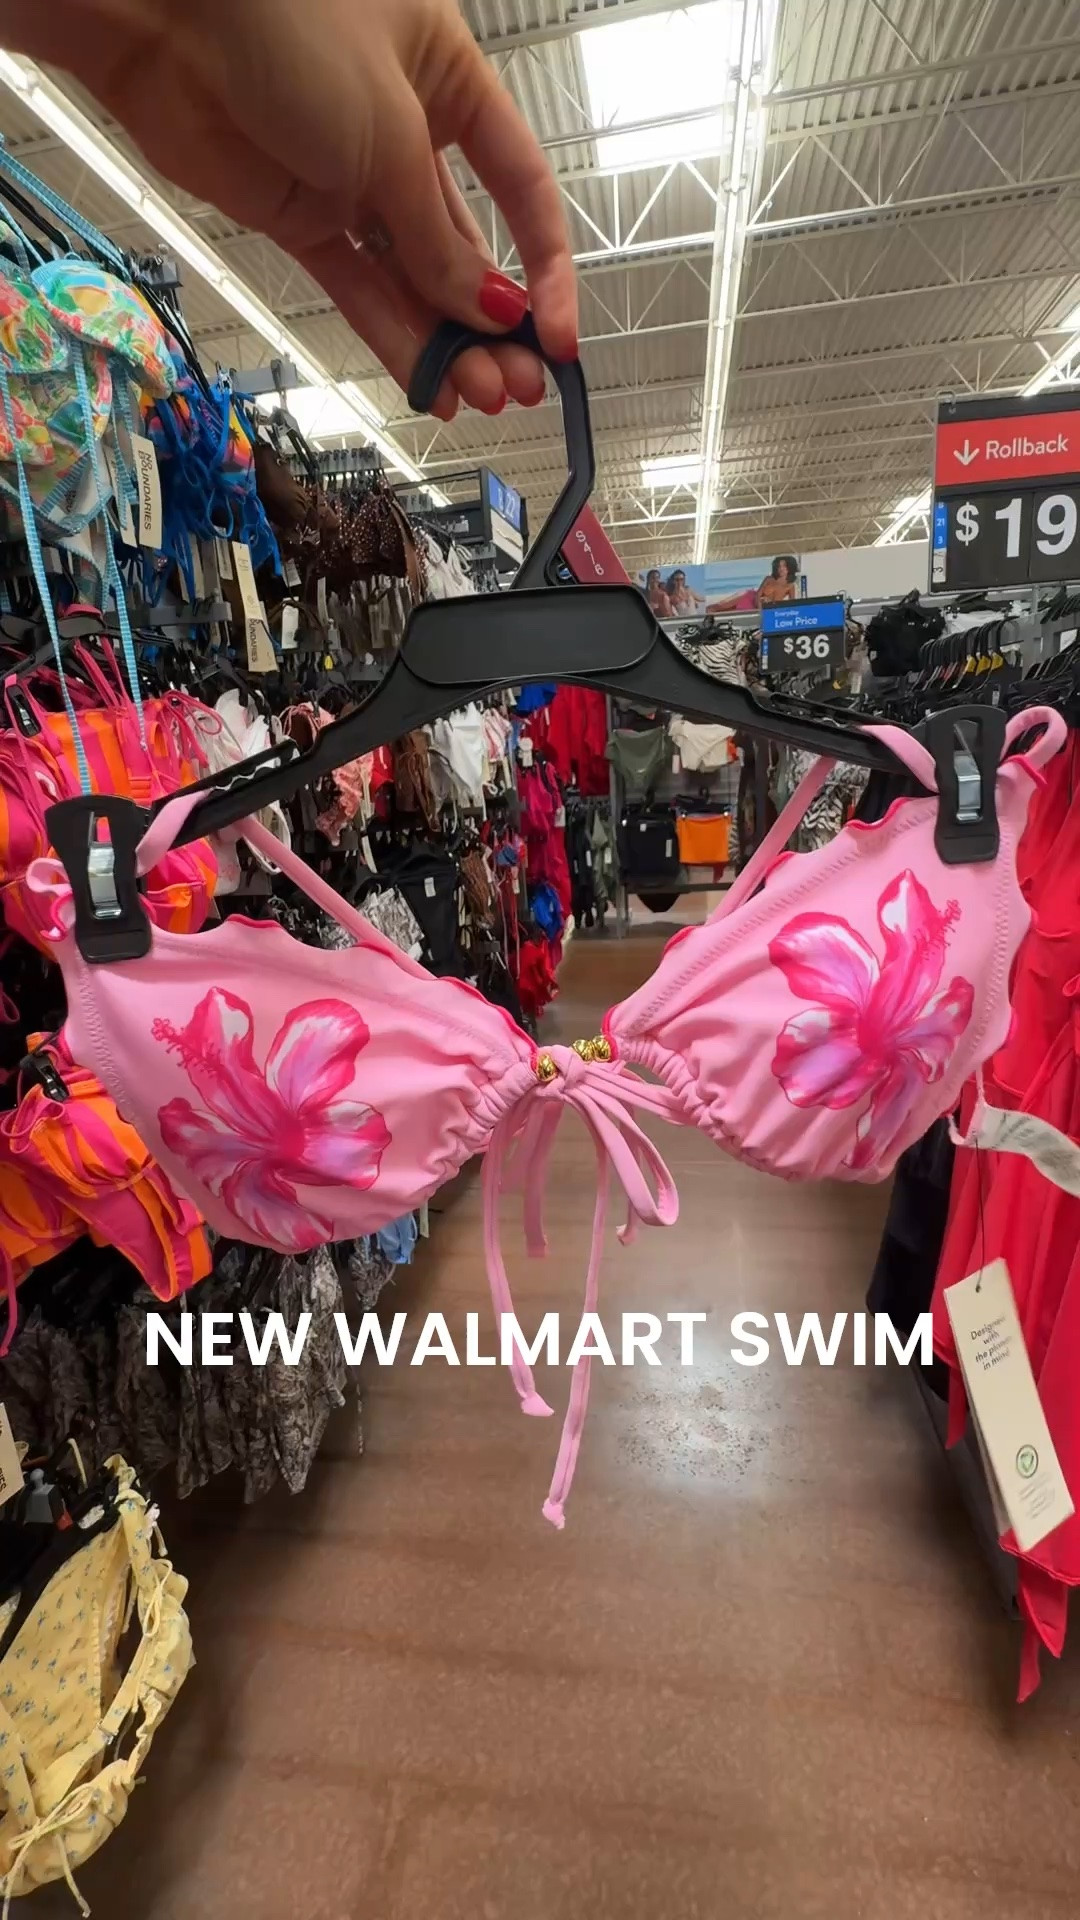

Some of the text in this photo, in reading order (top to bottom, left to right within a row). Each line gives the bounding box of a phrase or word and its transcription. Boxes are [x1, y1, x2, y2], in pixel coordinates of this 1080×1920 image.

[986, 433, 1069, 460] Rollback
[144, 452, 153, 471] NO
[138, 449, 152, 531] BOUNDARIES
[937, 518, 945, 527] 21
[937, 536, 944, 545] 3
[774, 616, 818, 628] Low Price
[783, 634, 830, 660] $36
[983, 1330, 1000, 1345] with
[975, 1350, 988, 1363] the
[982, 1361, 991, 1371] in
